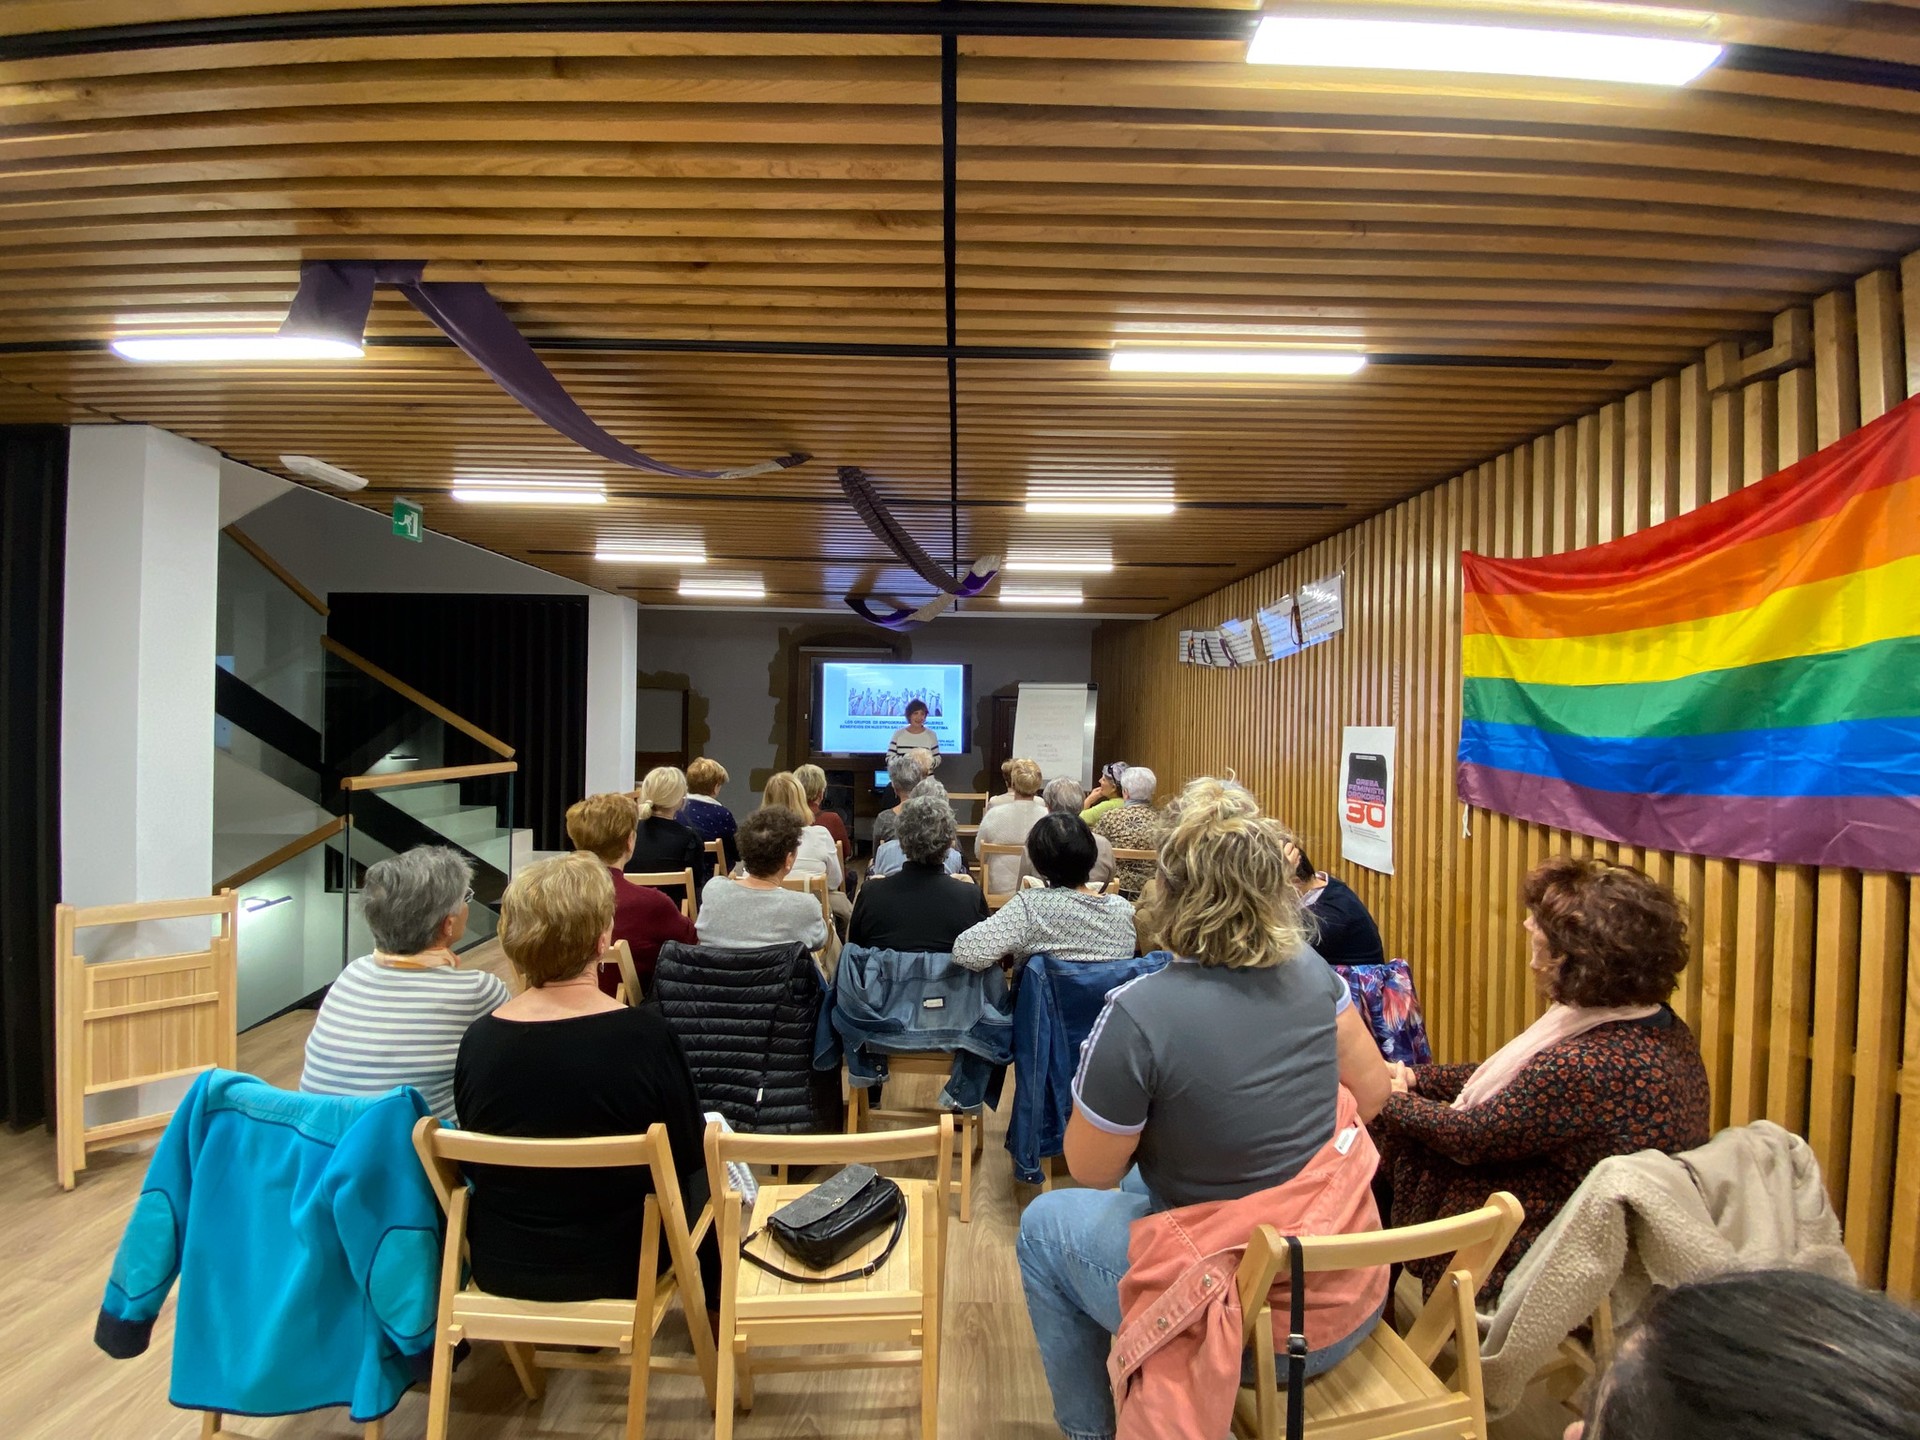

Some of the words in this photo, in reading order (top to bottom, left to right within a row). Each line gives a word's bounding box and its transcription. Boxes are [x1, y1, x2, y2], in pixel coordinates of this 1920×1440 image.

[1356, 778, 1379, 788] GREBA
[1348, 784, 1385, 796] FEMINISTA
[1346, 800, 1386, 828] 30
